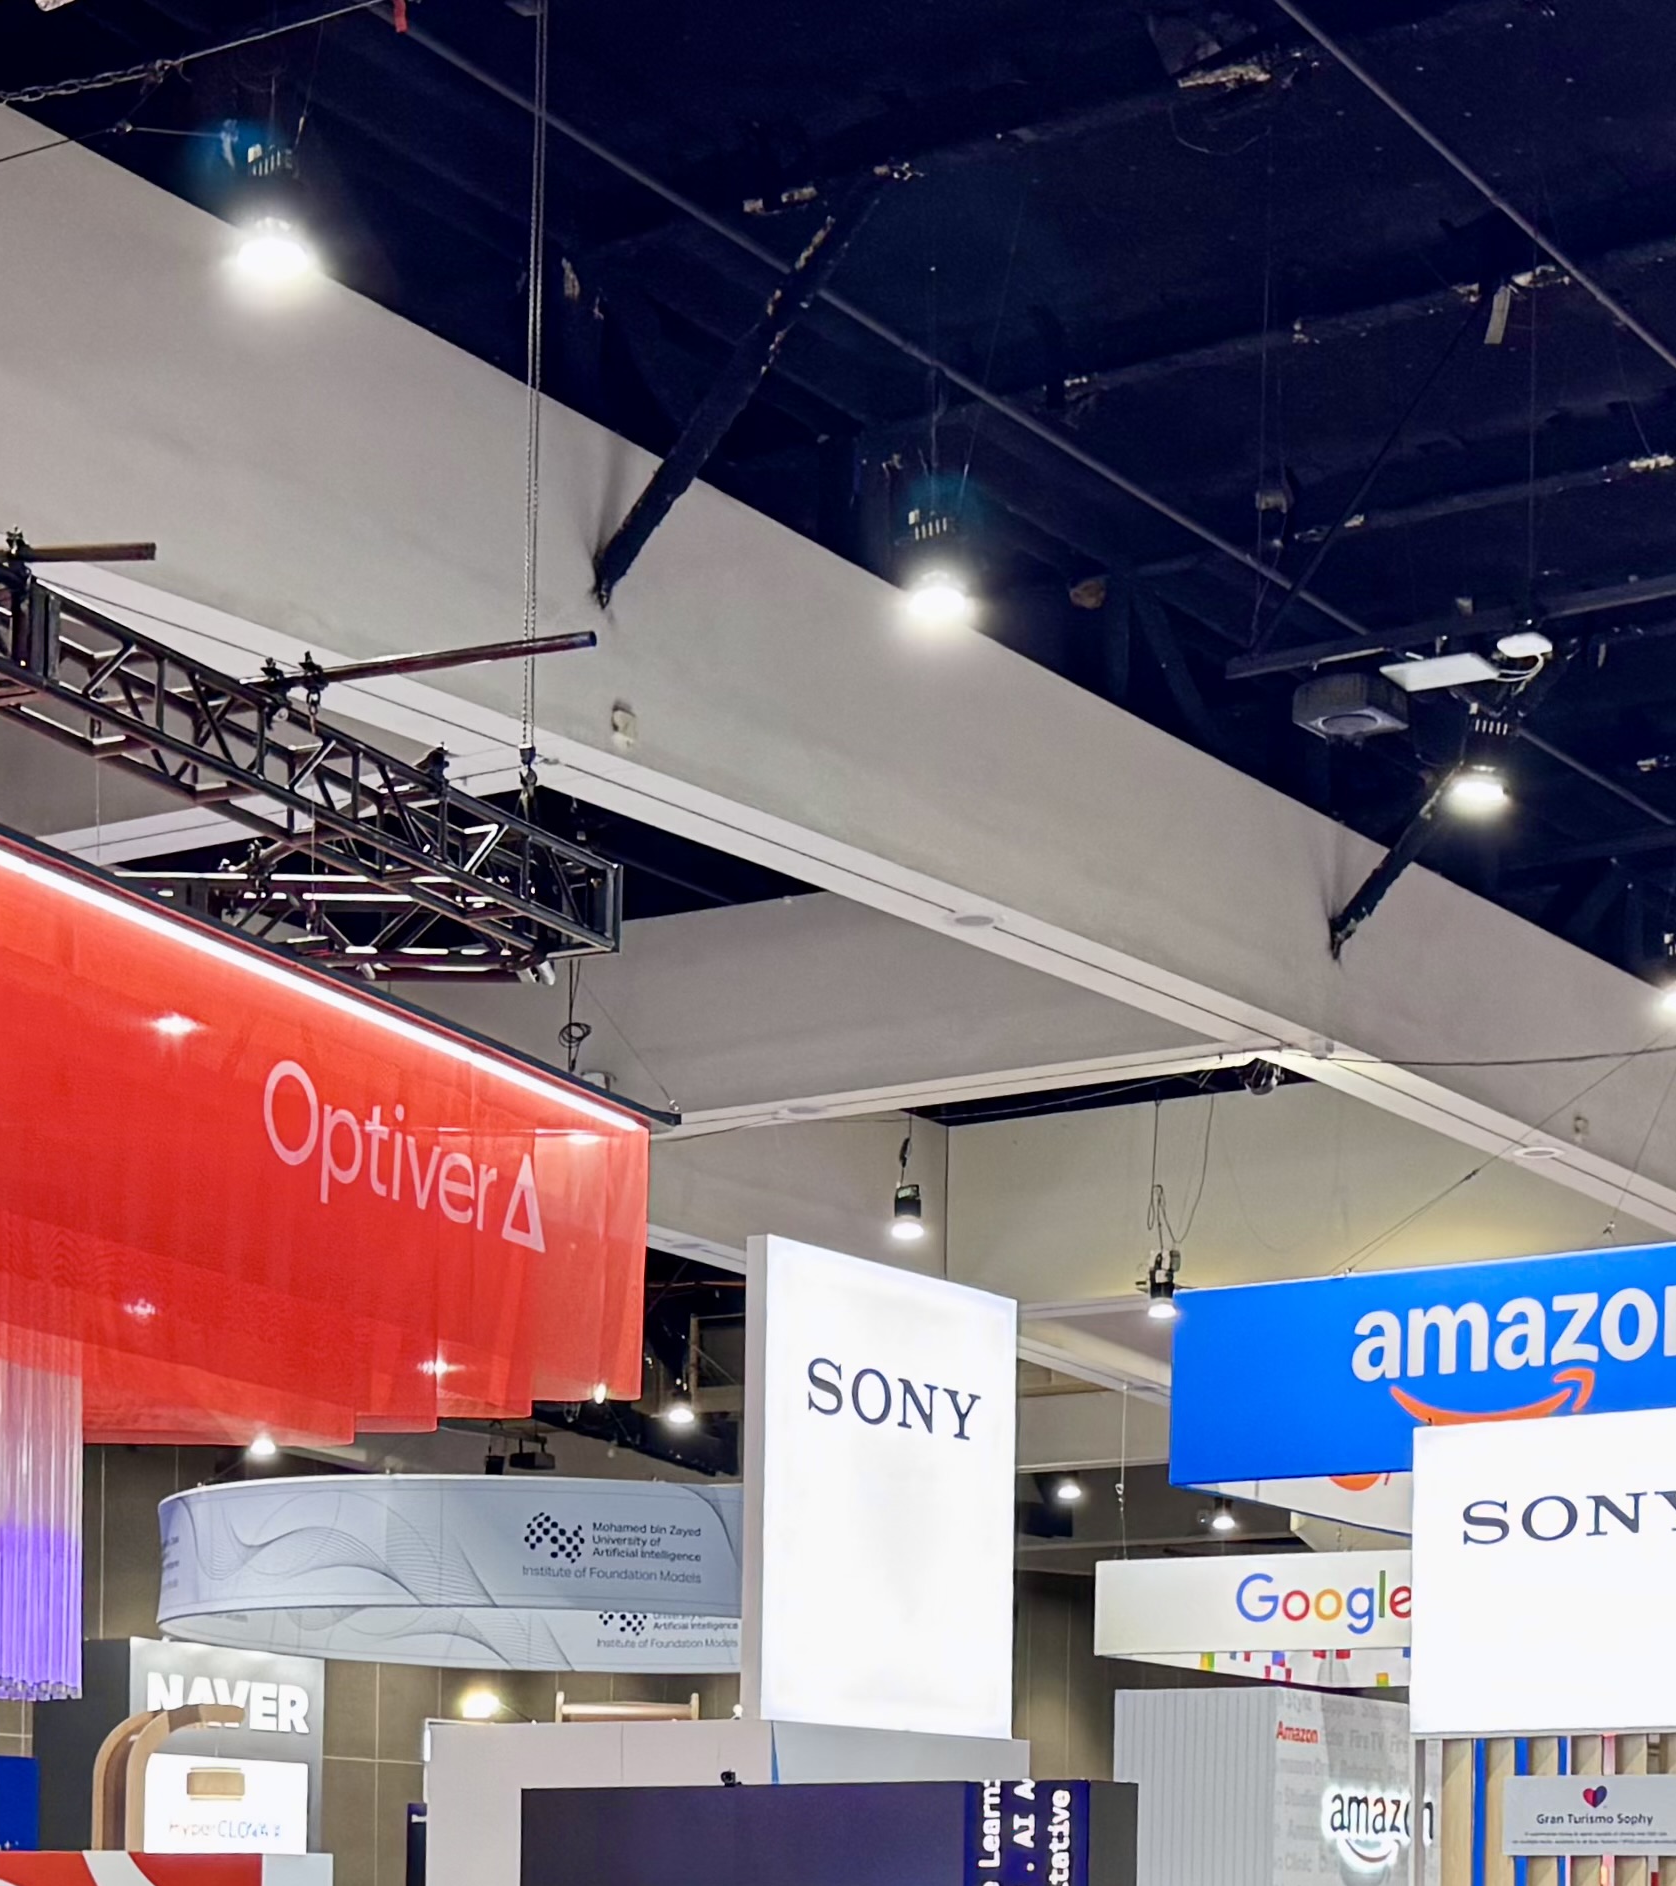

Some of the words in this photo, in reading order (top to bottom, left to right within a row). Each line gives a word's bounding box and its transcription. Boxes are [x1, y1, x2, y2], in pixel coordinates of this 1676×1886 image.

[263, 1058, 500, 1236] Optiver
[807, 1357, 981, 1441] SONY
[592, 1522, 647, 1535] Mohamed
[650, 1523, 667, 1535] bin
[669, 1525, 702, 1541] Zayed
[592, 1535, 648, 1548] University
[650, 1537, 661, 1547] of
[592, 1547, 638, 1559] Artificial
[640, 1549, 701, 1562] Intelligence
[522, 1565, 571, 1578] Institute
[574, 1566, 588, 1578] of
[590, 1567, 658, 1581] Foundation
[660, 1571, 702, 1584] Models
[1235, 1570, 1411, 1635] Google
[147, 1671, 310, 1734] NAVER
[1276, 1720, 1318, 1744] Amazon
[1012, 1813, 1035, 1848] AI
[1536, 1813, 1565, 1825] Gran
[1567, 1813, 1614, 1825] Turismo
[1616, 1813, 1654, 1827] Sophy
